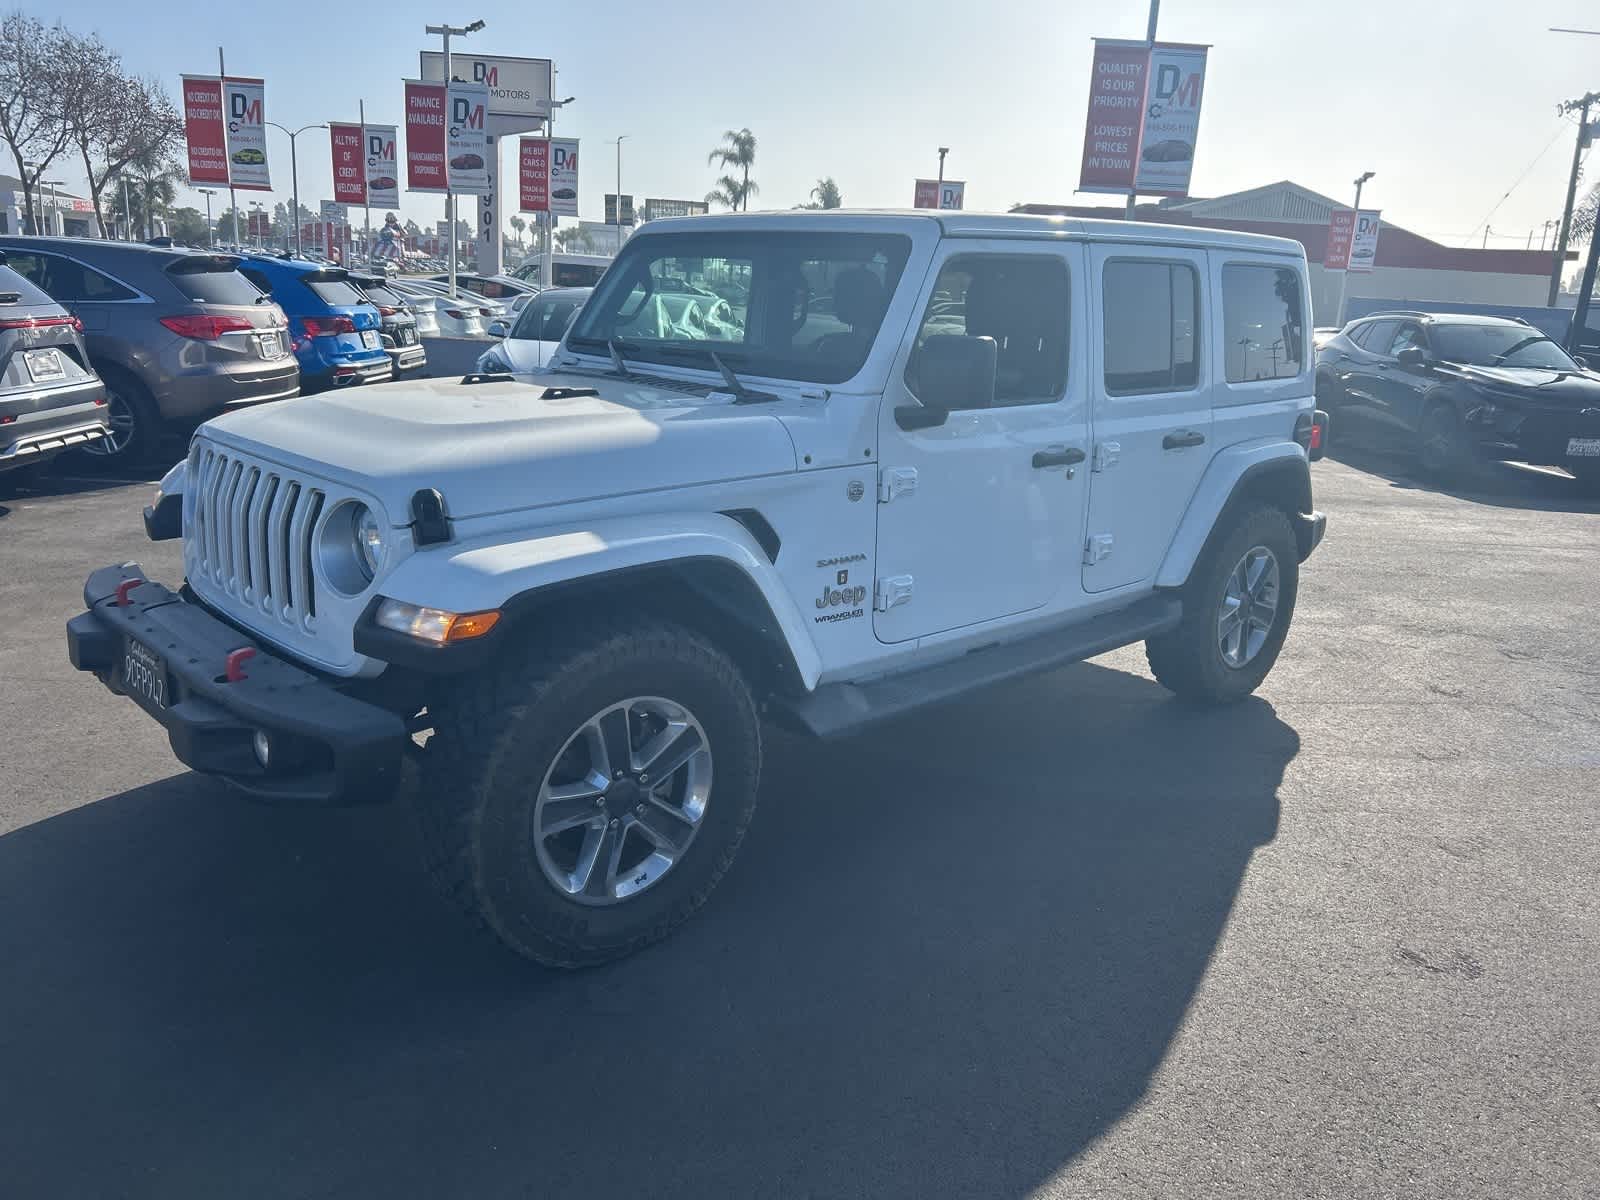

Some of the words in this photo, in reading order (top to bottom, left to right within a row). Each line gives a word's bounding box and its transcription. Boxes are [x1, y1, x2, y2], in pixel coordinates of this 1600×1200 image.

[1098, 62, 1143, 75] QUALITY
[1102, 80, 1111, 90] IS
[1112, 80, 1136, 91] OUR
[1156, 64, 1201, 108] DM
[490, 89, 530, 100] MOTORS
[410, 96, 440, 108] FINANCE
[1094, 96, 1140, 108] PRIORITY
[232, 93, 261, 125] DM
[454, 97, 484, 129] DM
[408, 112, 444, 126] AVAILABLE
[1094, 125, 1133, 137] LOWEST
[335, 136, 344, 146] ALL
[344, 136, 359, 146] TYPE
[370, 136, 395, 161] DM
[1095, 142, 1128, 153] PRICES
[344, 152, 352, 161] OF
[522, 158, 540, 167] CARS
[1088, 158, 1098, 168] IN
[1102, 158, 1131, 169] TOWN
[338, 167, 358, 177] CREDIT
[522, 170, 546, 179] TRUCKS
[336, 183, 362, 194] WELCOME
[816, 554, 867, 568] SAHARA
[816, 584, 866, 608] Jeep
[815, 608, 864, 624] WRANGLER
